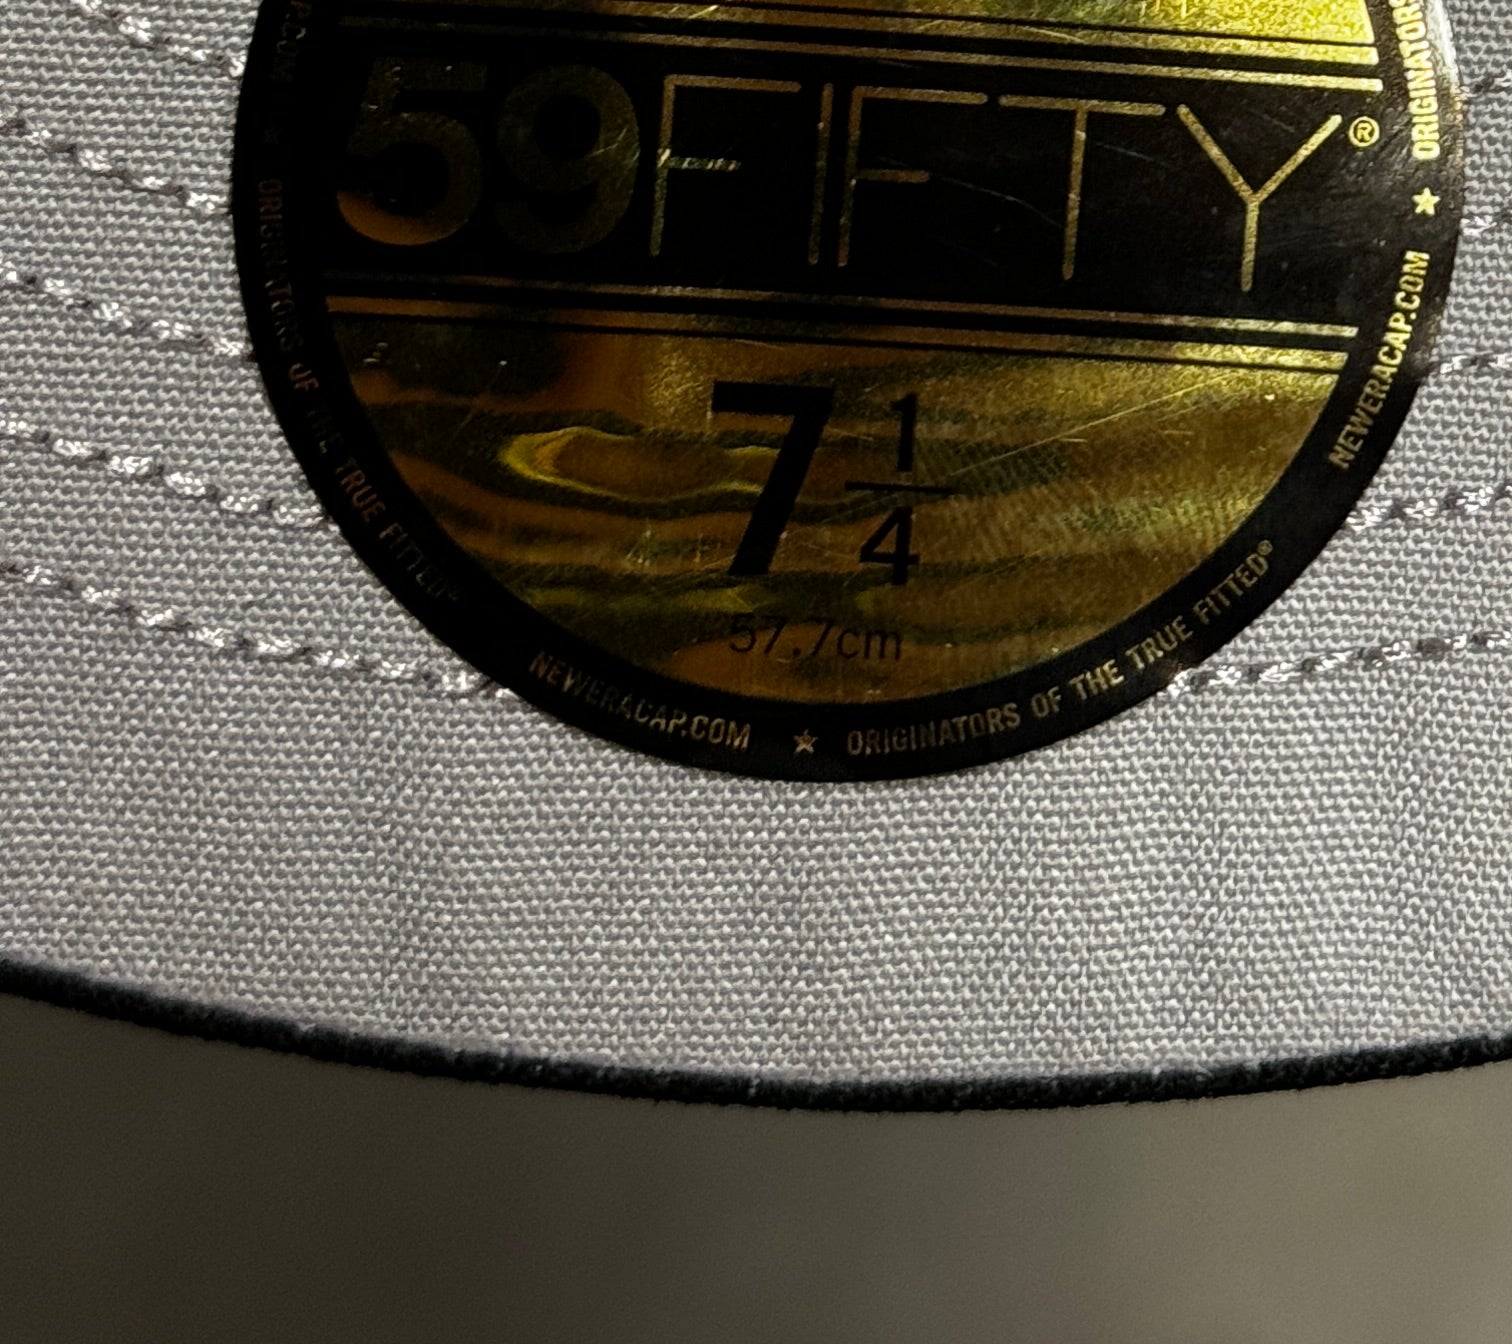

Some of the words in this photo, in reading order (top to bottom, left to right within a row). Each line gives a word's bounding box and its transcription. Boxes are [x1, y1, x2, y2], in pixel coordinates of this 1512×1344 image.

[1327, 250, 1431, 470] NEWERACAP.COM
[712, 381, 835, 575] 7
[528, 647, 751, 753] NEWERACAP.COM
[730, 614, 901, 661] 57.7cm
[846, 703, 1022, 758] ORIGINATORS
[1031, 688, 1065, 719] OF
[1068, 658, 1126, 701] THE
[1125, 615, 1195, 672] TRUE
